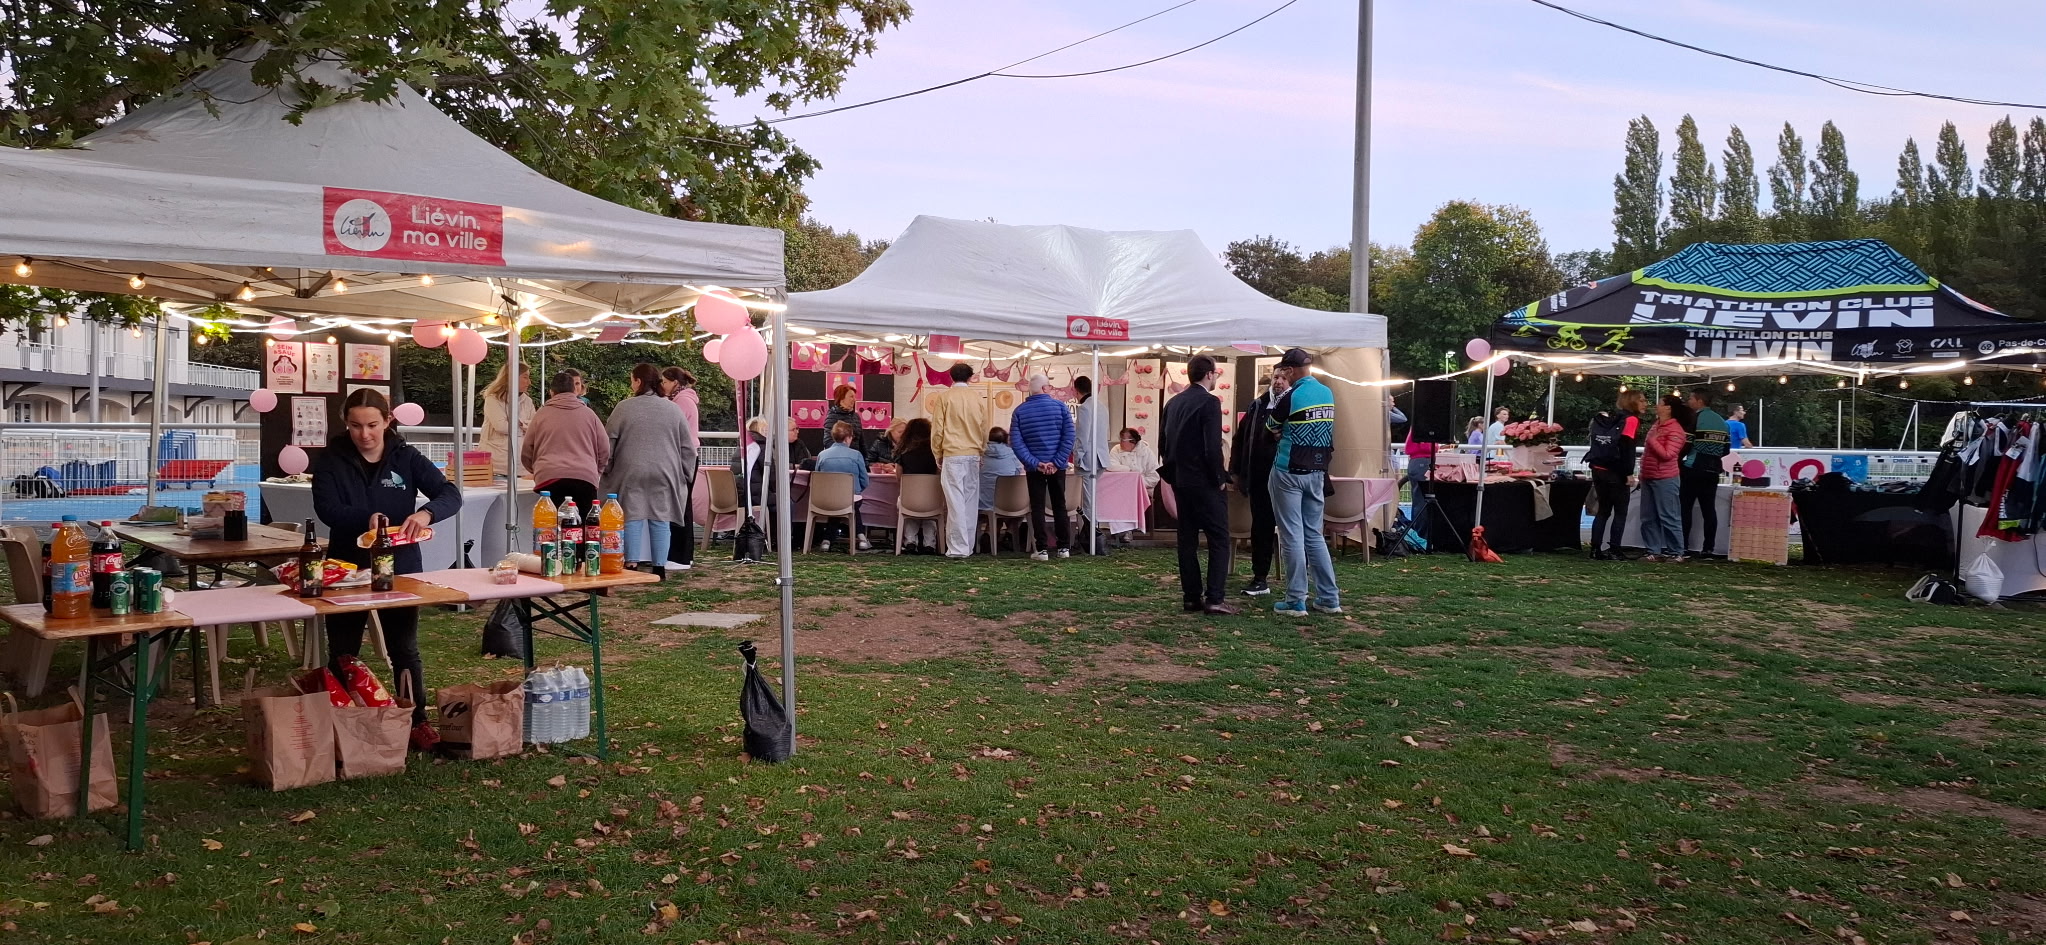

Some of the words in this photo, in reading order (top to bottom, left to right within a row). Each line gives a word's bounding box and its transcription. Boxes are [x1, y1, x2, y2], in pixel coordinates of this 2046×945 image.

[403, 229, 440, 247] ma
[445, 231, 488, 251] ville
[1639, 290, 1832, 312] TRIATHLON
[1838, 296, 1934, 309] CLUB
[1629, 303, 1934, 330] LIEVIN
[1093, 328, 1106, 336] ma
[1107, 329, 1123, 337] ville
[1686, 329, 1786, 340] TRIATHLON
[1787, 331, 1834, 340] CLUB
[1684, 339, 1833, 361] LIEVIN
[1980, 343, 1993, 351] 62
[1998, 338, 2046, 347] Pas-de-C
